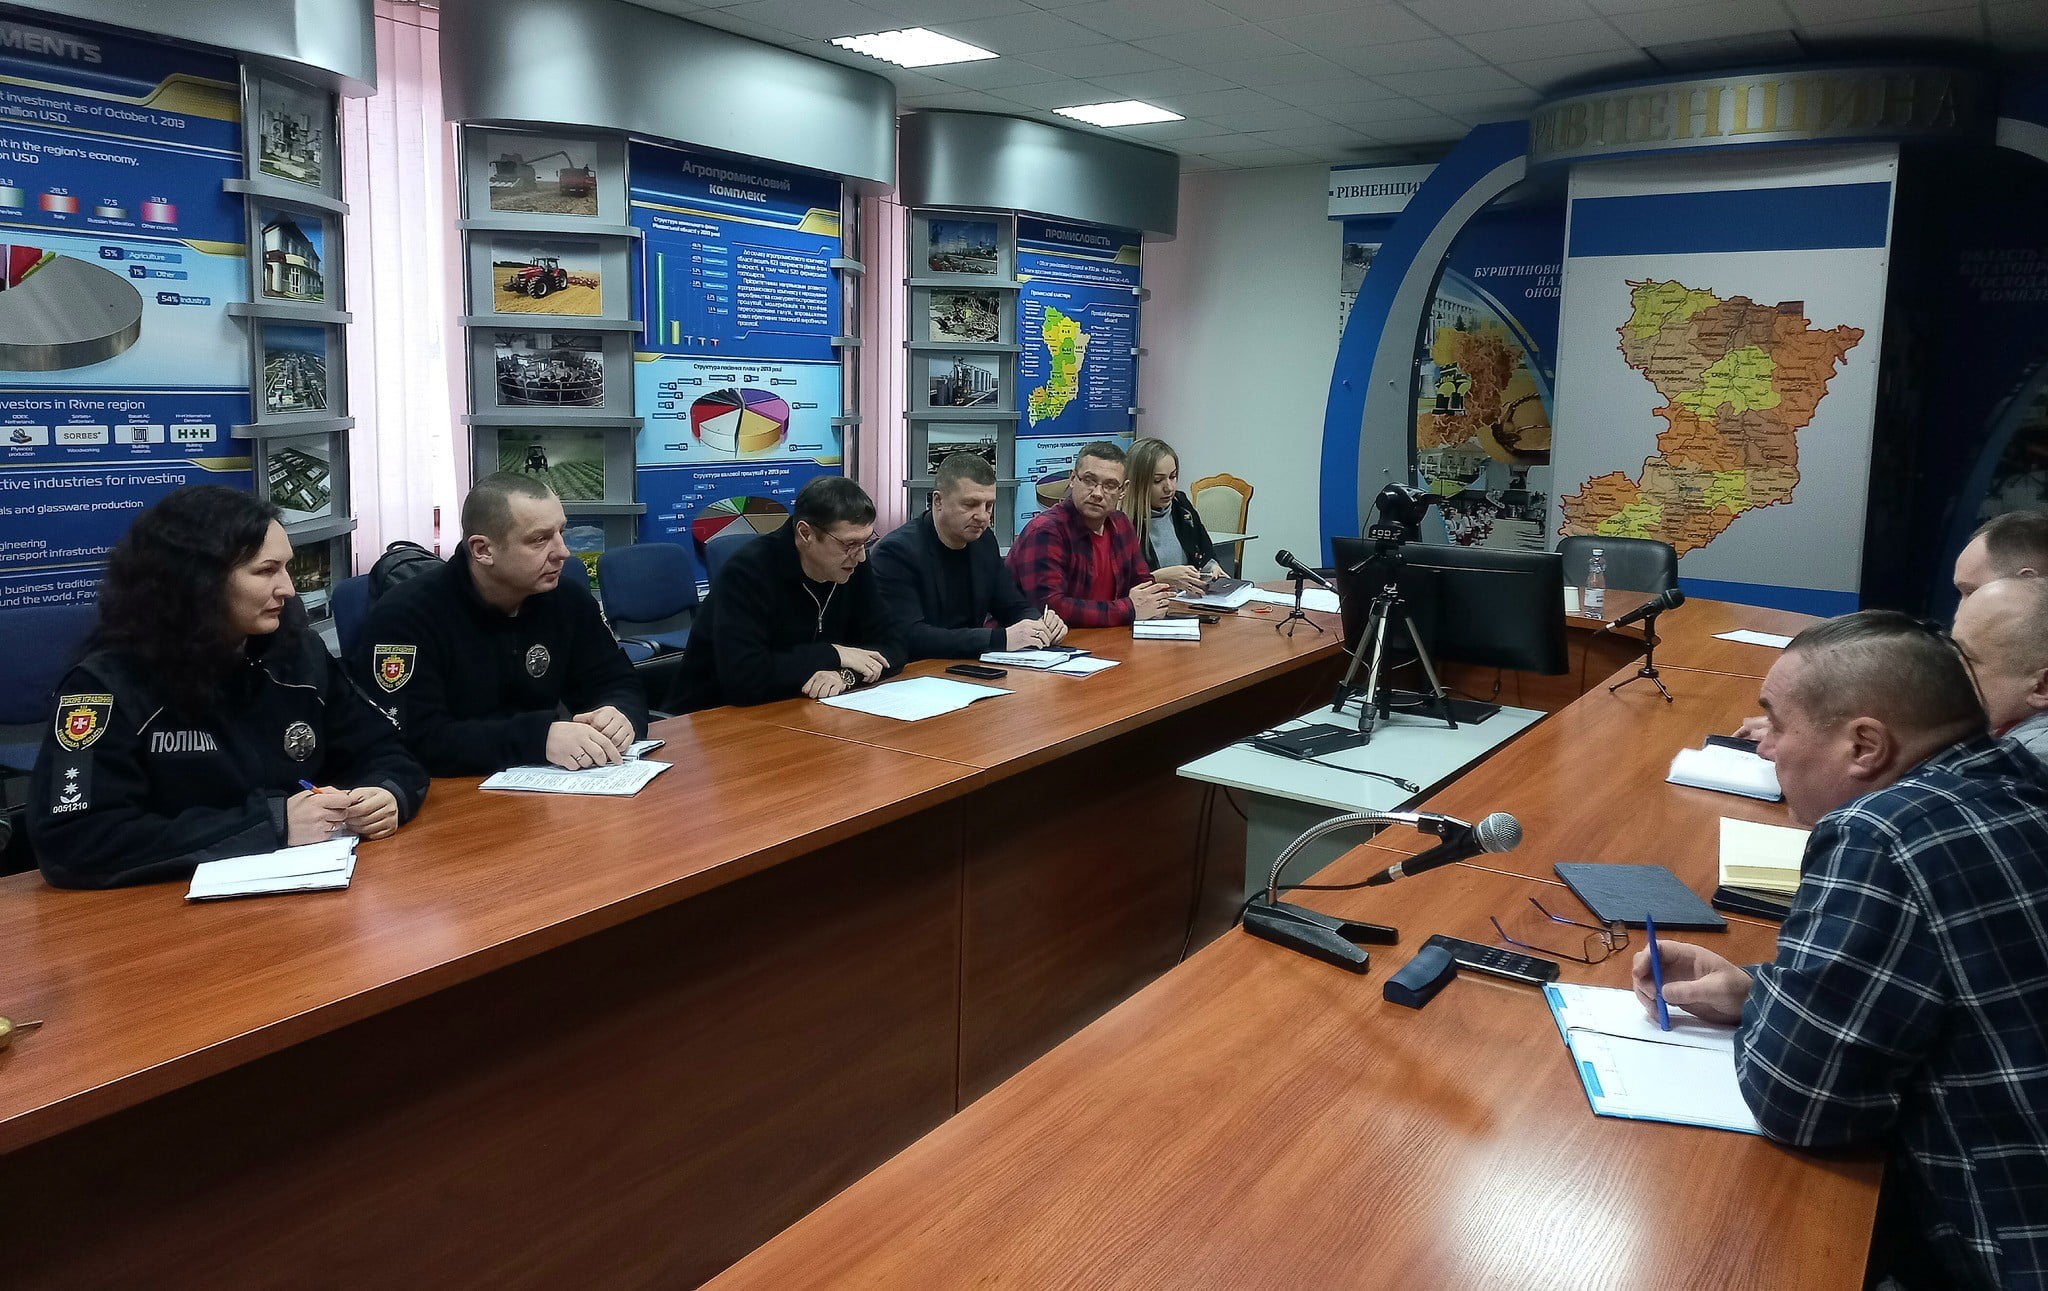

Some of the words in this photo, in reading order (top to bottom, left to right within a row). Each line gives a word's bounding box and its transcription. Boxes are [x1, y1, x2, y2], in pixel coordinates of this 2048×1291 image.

[0, 105, 38, 120] million
[40, 110, 70, 124] USD.
[6, 91, 73, 111] investment
[74, 104, 88, 114] as
[90, 105, 103, 116] of
[105, 107, 148, 123] October
[160, 116, 186, 129] 2013
[11, 140, 21, 150] in
[22, 140, 42, 152] the
[43, 145, 87, 158] region's
[89, 151, 140, 166] economy.
[11, 152, 39, 164] USD
[1045, 228, 1111, 246] ПРОМИСЛОВІСТЬ
[104, 249, 118, 258] 5%
[129, 251, 166, 261] Agriculture
[133, 267, 144, 276] 1%
[155, 270, 175, 279] Other
[1474, 264, 1562, 278] БУРШТИНОВИ
[161, 294, 179, 304] 54%
[1525, 287, 1562, 298] ОНОВ
[54, 399, 66, 410] in
[69, 399, 105, 410] Rivne
[107, 400, 145, 412] region
[178, 428, 210, 439] H+H
[34, 474, 103, 488] industries
[106, 474, 125, 486] for
[128, 472, 186, 488] investing
[14, 505, 35, 514] and
[37, 502, 90, 515] glassware
[91, 499, 144, 511] production
[5, 584, 54, 595] business
[22, 595, 41, 605] the
[42, 591, 75, 603] world.
[52, 801, 88, 814] 0051210
